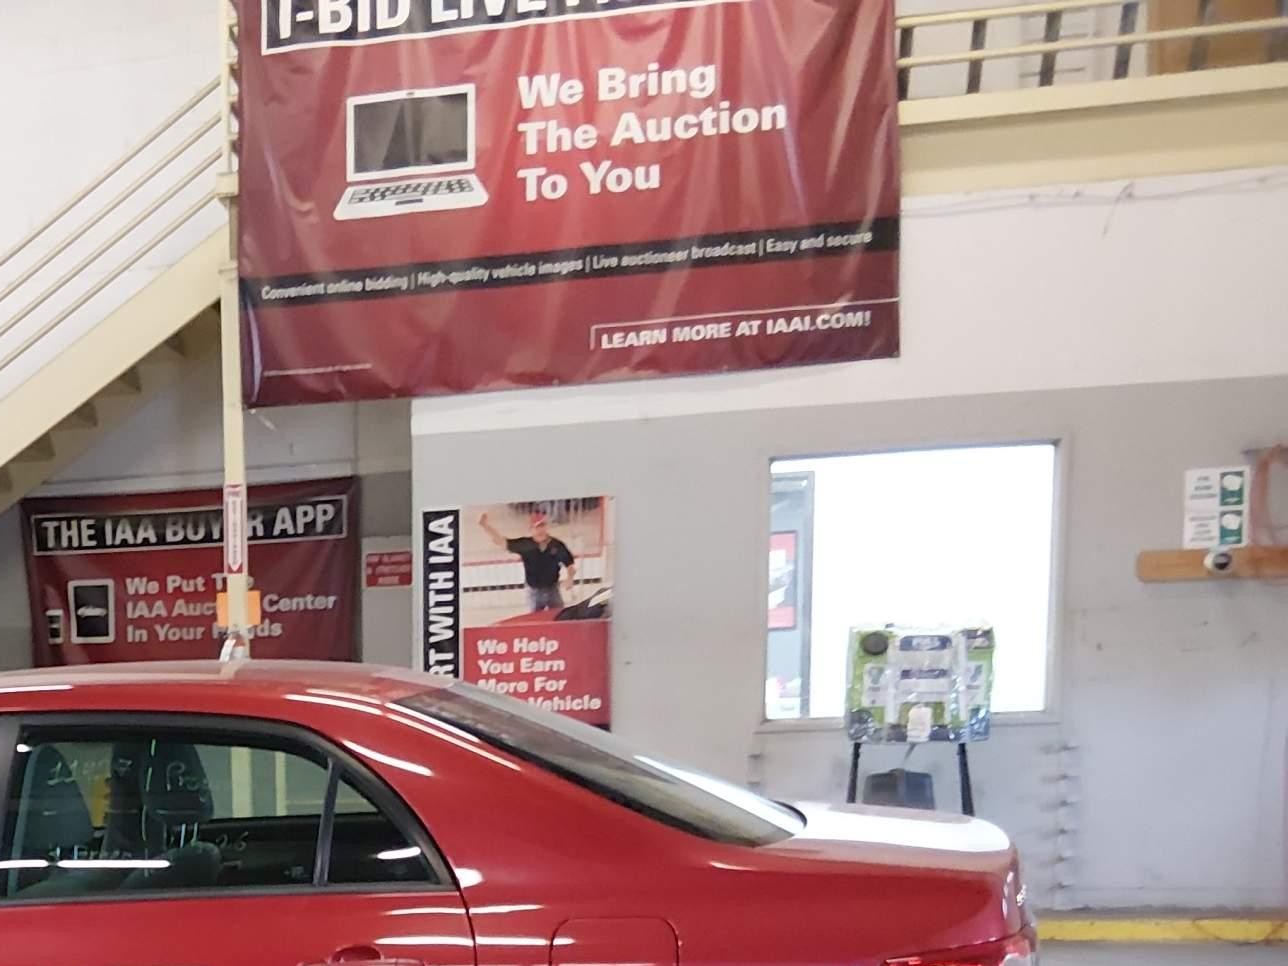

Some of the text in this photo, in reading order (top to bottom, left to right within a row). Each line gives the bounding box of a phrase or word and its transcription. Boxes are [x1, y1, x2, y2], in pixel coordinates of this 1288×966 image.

[517, 63, 716, 109] We Bring
[517, 101, 787, 155] The Auction
[517, 160, 661, 201] To You
[261, 282, 325, 300] Convenient
[365, 275, 408, 291] bidding
[417, 266, 491, 288] High-quality
[538, 260, 584, 276] images
[592, 253, 619, 270] Live
[690, 241, 757, 260] broadcast
[765, 237, 798, 255] Easy
[800, 232, 824, 249] and
[826, 230, 873, 247] secure
[601, 310, 872, 349] LEARN MORE AT IAAI.COM!
[41, 518, 97, 549] THE
[105, 516, 158, 546] IAA
[165, 507, 263, 543] BUYR
[272, 503, 335, 536] APP
[428, 515, 455, 564] IAA
[126, 576, 160, 595] We
[167, 574, 206, 594] Put
[126, 600, 168, 619] IAA
[262, 593, 338, 613] Center
[428, 571, 455, 643] WITH
[127, 624, 148, 643] In
[155, 623, 206, 641] Your
[477, 637, 560, 655] We Help
[477, 658, 566, 675] You Earn
[477, 676, 567, 694] More For
[527, 694, 602, 712] Vehicle
